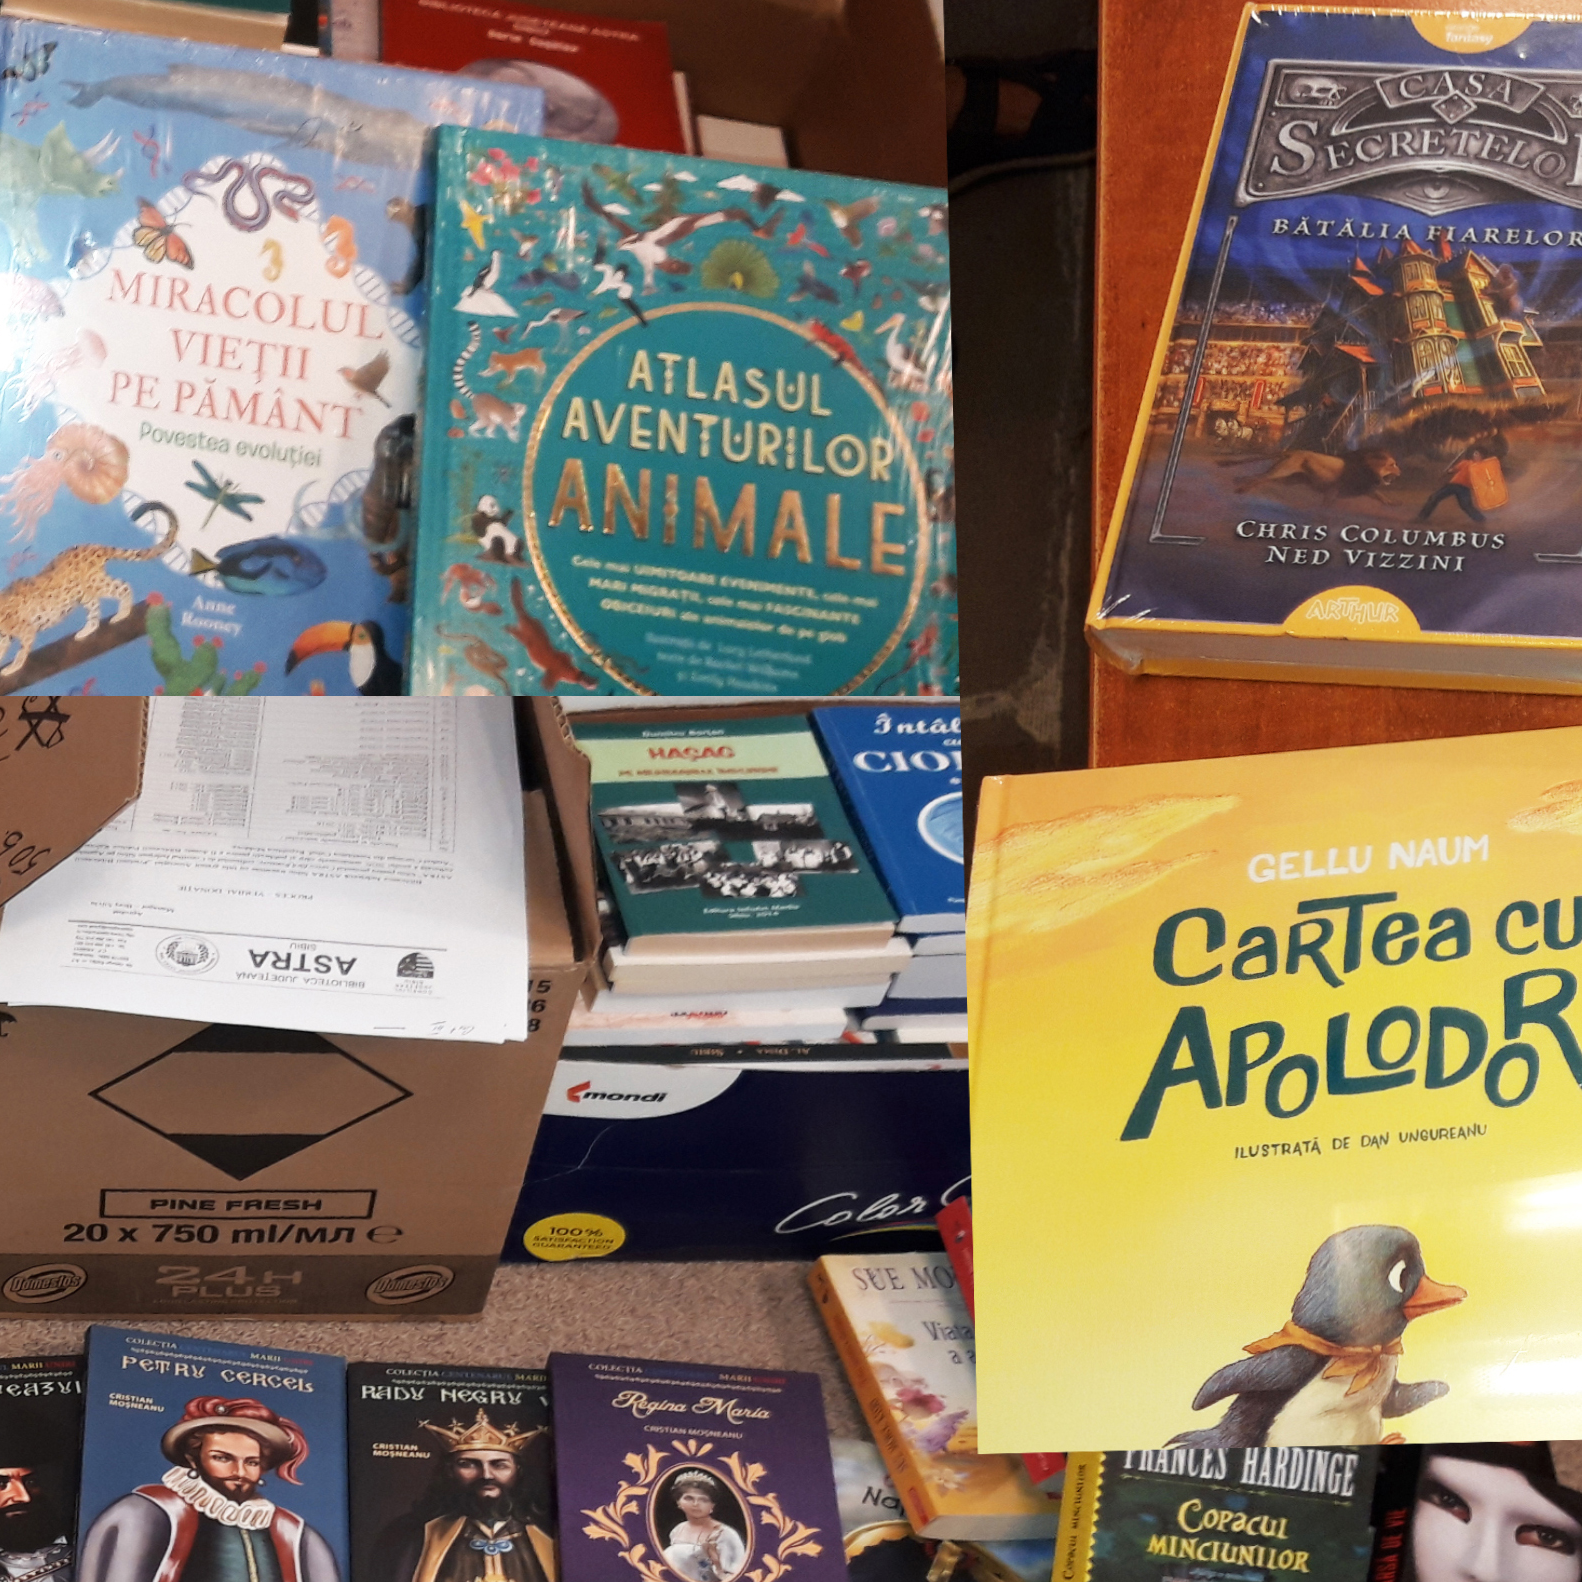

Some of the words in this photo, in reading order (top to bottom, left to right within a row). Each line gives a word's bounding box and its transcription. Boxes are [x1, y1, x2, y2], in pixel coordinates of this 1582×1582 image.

[1445, 32, 1494, 46] fantasy
[1400, 71, 1513, 103] CASA
[1272, 216, 1412, 241] BĂTĂLIA
[1427, 225, 1582, 247] FIARELOR
[107, 268, 385, 341] MIRACOLUL
[170, 328, 311, 385] VIEȚII
[628, 349, 833, 417] ATLASUL
[109, 370, 161, 410] PE
[172, 376, 363, 439] PĂMÂNT
[139, 420, 230, 455] Povestea
[236, 438, 322, 468] evoluției
[562, 397, 895, 482] AVENTURILOR
[547, 458, 906, 577] ANIMALE
[1236, 520, 1328, 541] CHRIS
[1340, 524, 1506, 550] COLUMBUS
[1265, 545, 1330, 566] NED
[1343, 549, 1466, 573] VIZZINI
[192, 595, 236, 616] Anne
[1305, 597, 1399, 624] ARTHUR
[181, 611, 243, 637] Rooney
[1247, 845, 1373, 884] GELLU
[1388, 834, 1490, 870] NAUM
[248, 948, 358, 977] ASTRA
[303, 976, 366, 989] BIBLIOTECA
[582, 1091, 667, 1103] mondi
[1234, 1137, 1321, 1159] ILUSTRATĂ
[1331, 1136, 1350, 1150] DE
[1360, 1131, 1391, 1151] DAN
[1398, 1122, 1488, 1144] UNGUREANU
[150, 1198, 215, 1212] PINE
[226, 1198, 322, 1212] FRESH
[775, 1192, 927, 1234] Color
[63, 1223, 108, 1243] 20
[117, 1226, 138, 1243] x
[153, 1223, 218, 1244] 750
[532, 1235, 615, 1244] SATISFACTION
[549, 1226, 603, 1237] 100%
[10, 1273, 80, 1296] Domestos
[171, 1285, 281, 1298] PLUS
[373, 1274, 449, 1295] Domestos
[852, 1267, 905, 1291] SUE
[911, 1265, 956, 1289] MO
[109, 1393, 154, 1405] CRISTIAN
[611, 1389, 687, 1420] Regina
[691, 1395, 770, 1425] Maria
[643, 1424, 687, 1435] CRISTIAN
[372, 1442, 418, 1451] CRISTIAN
[372, 1449, 430, 1459] MOȘNEANU
[1241, 1449, 1359, 1498] HARDINGE
[1145, 1534, 1309, 1574] MINCIUNILOR
